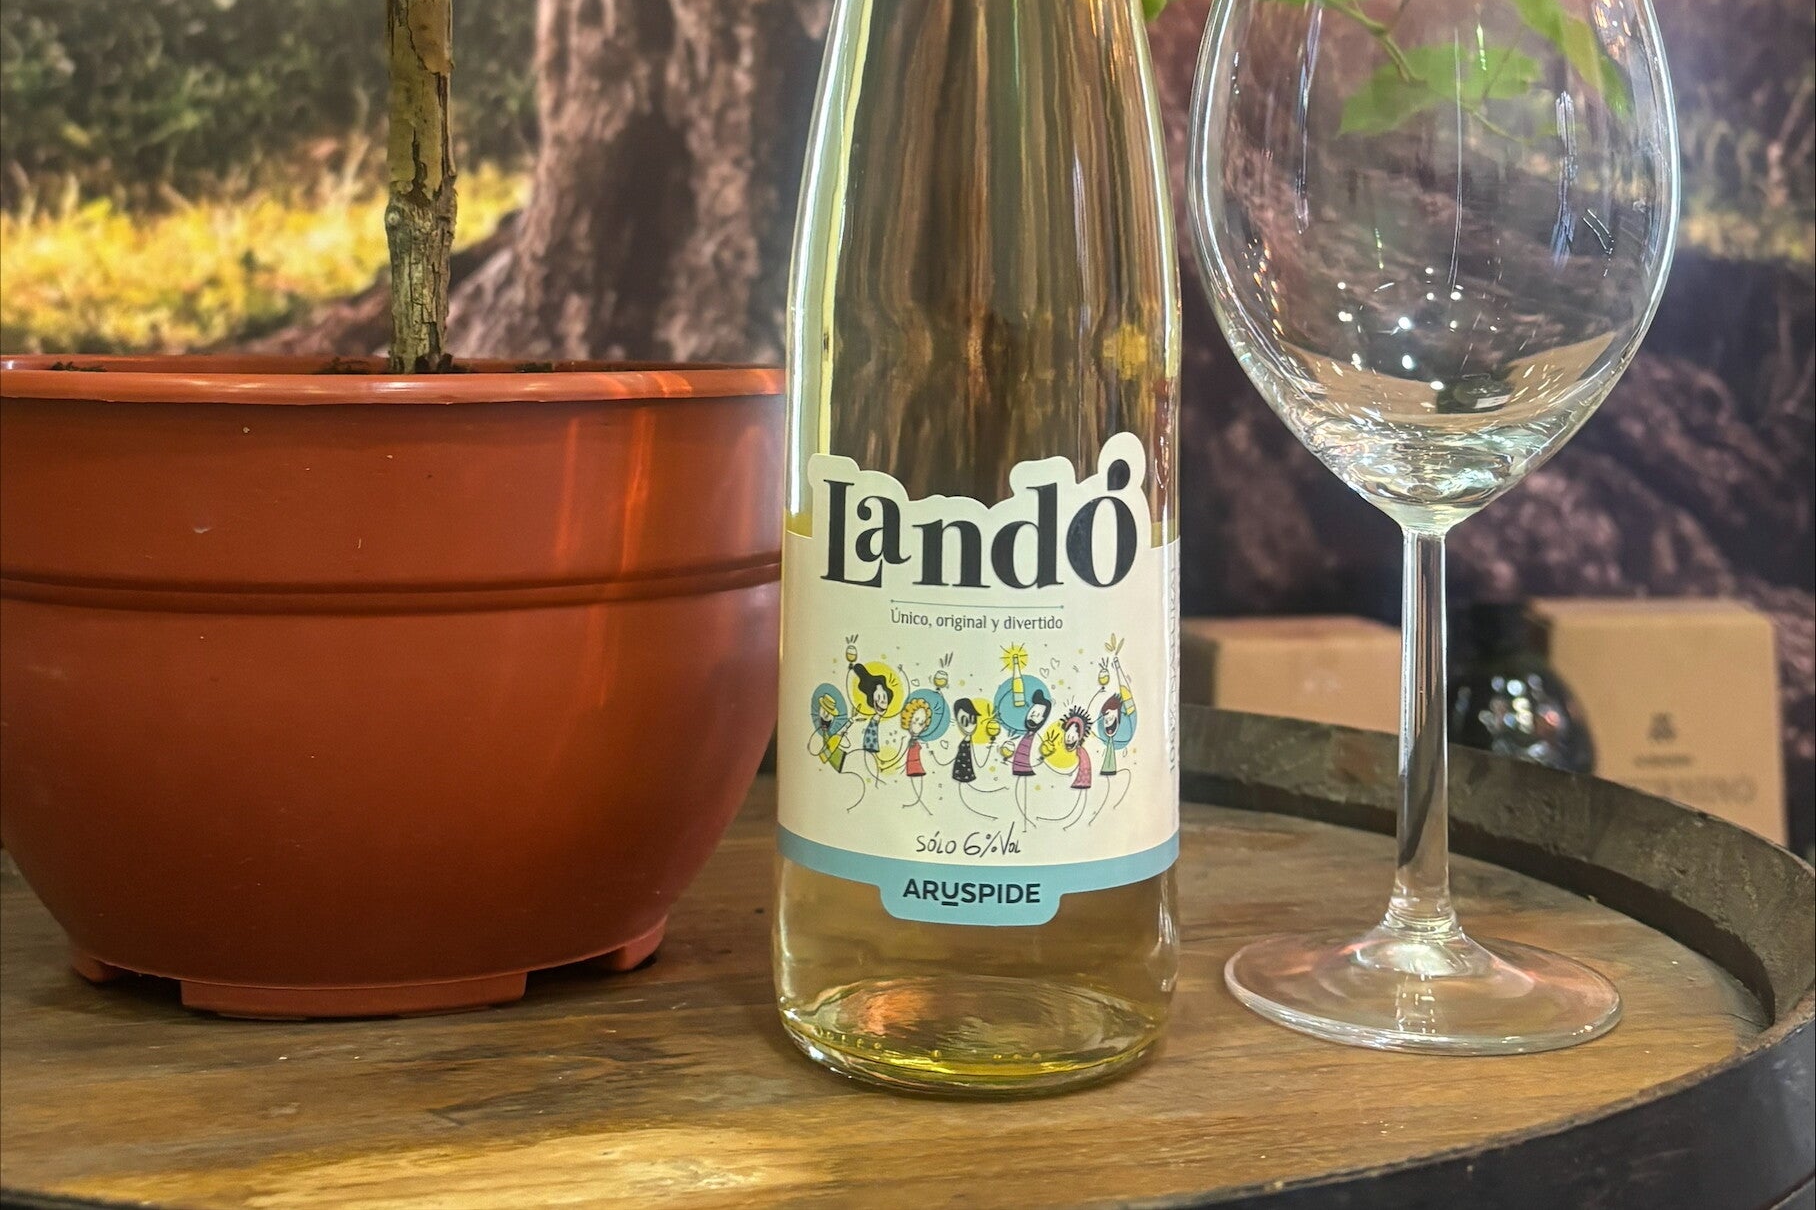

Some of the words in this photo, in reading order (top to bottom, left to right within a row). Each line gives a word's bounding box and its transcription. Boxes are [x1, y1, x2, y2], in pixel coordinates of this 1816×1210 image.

[820, 458, 1138, 589] Landó
[891, 607, 932, 628] Único,
[936, 615, 987, 631] original
[991, 619, 999, 633] y
[1003, 616, 1063, 630] divertido
[916, 831, 957, 854] SÓLO
[902, 878, 1040, 907] ARUSPIDE
